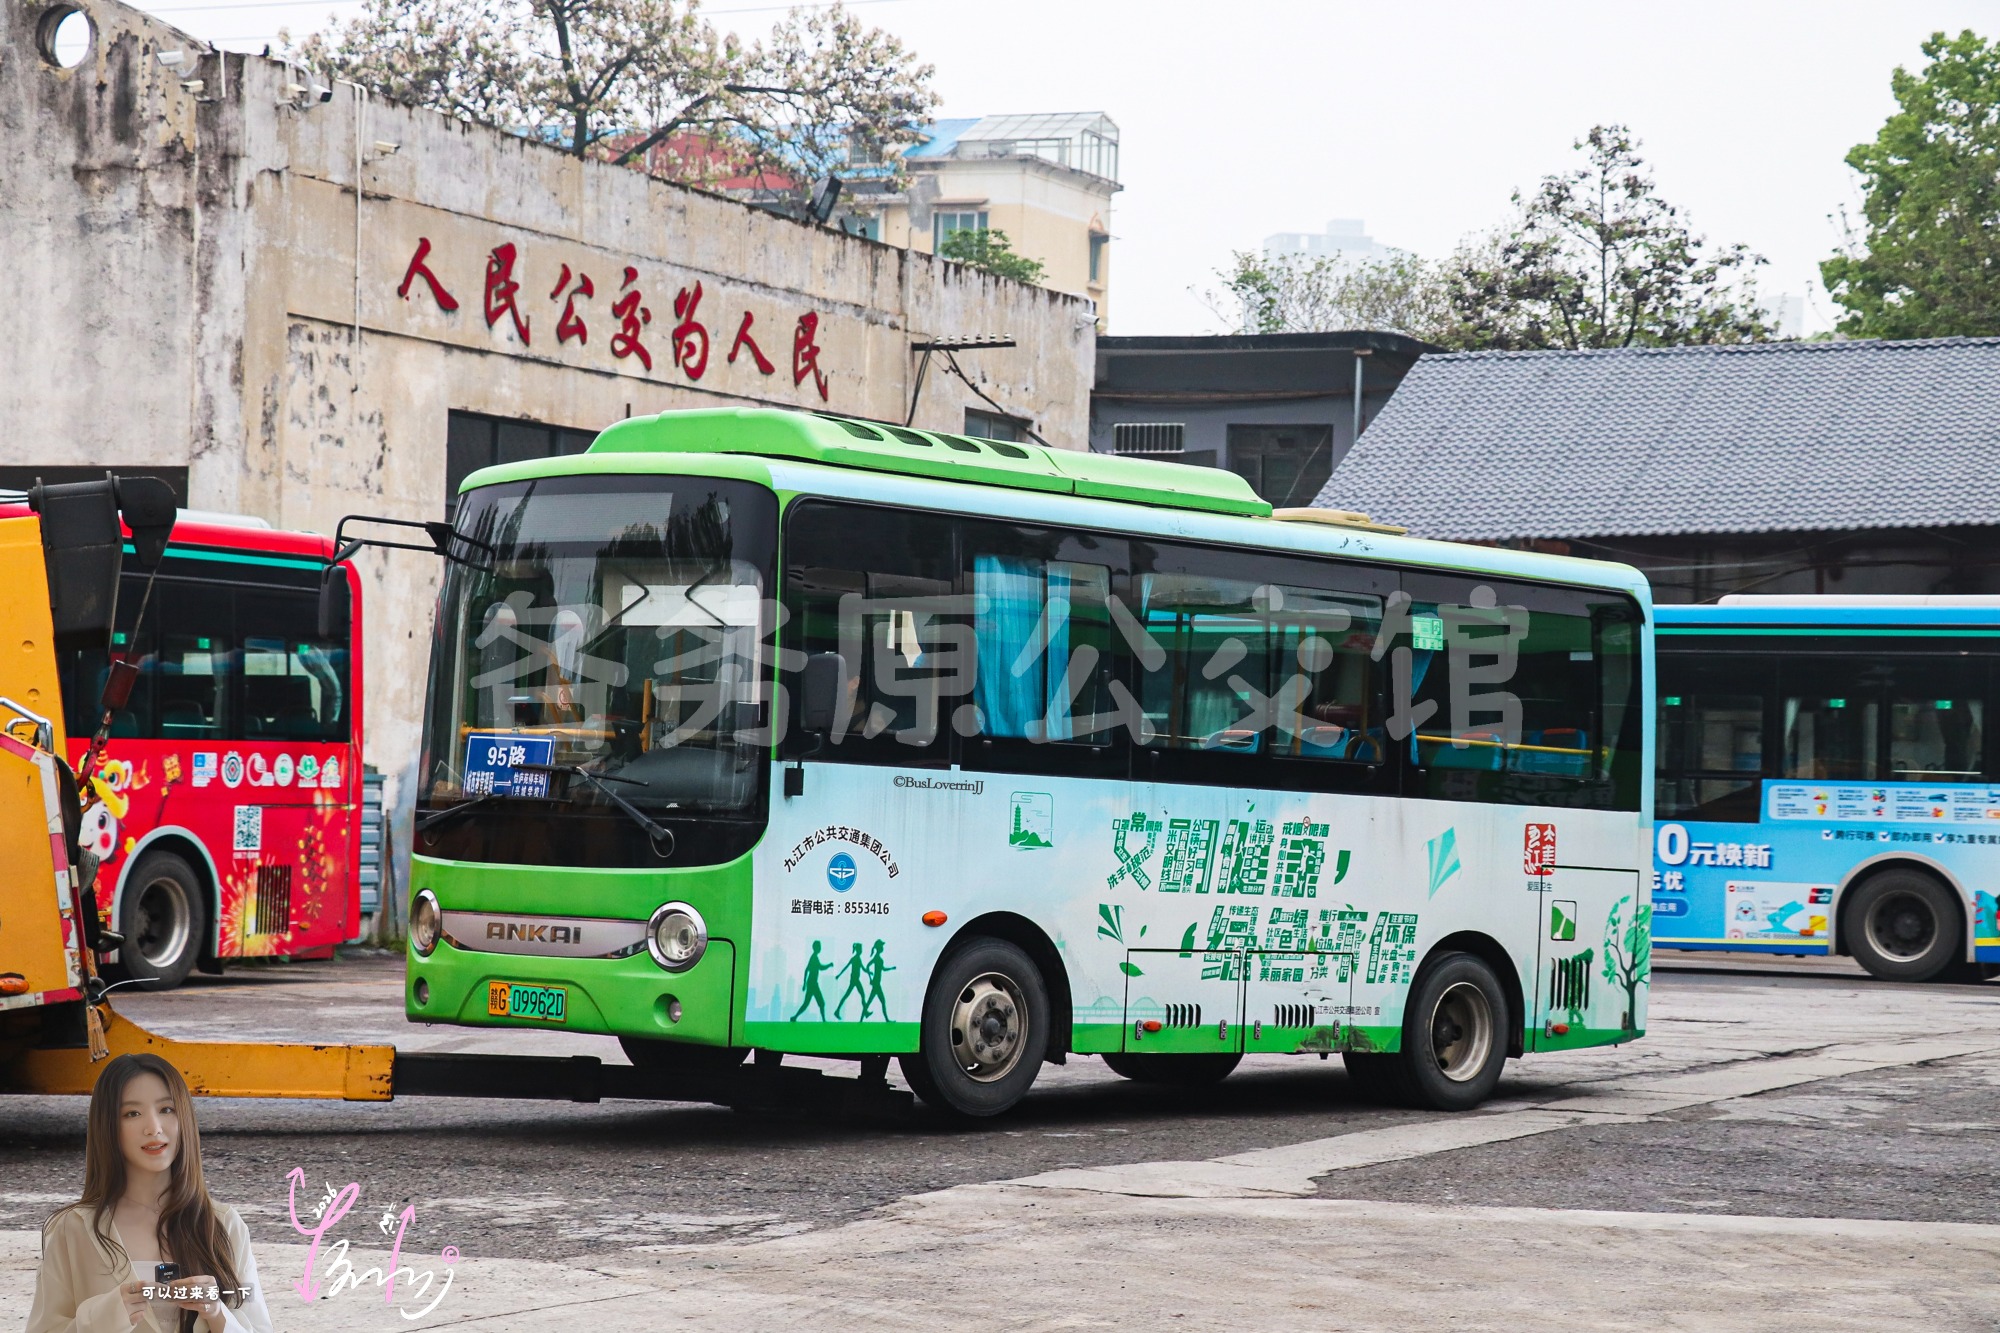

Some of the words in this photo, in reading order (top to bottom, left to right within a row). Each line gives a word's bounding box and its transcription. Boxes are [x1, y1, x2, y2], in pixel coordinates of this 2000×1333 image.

[398, 236, 829, 402] 人民公交为人民
[487, 745, 526, 768] 95路
[784, 825, 900, 879] 九江市公共交通集团公司
[486, 922, 581, 944] ANKAI
